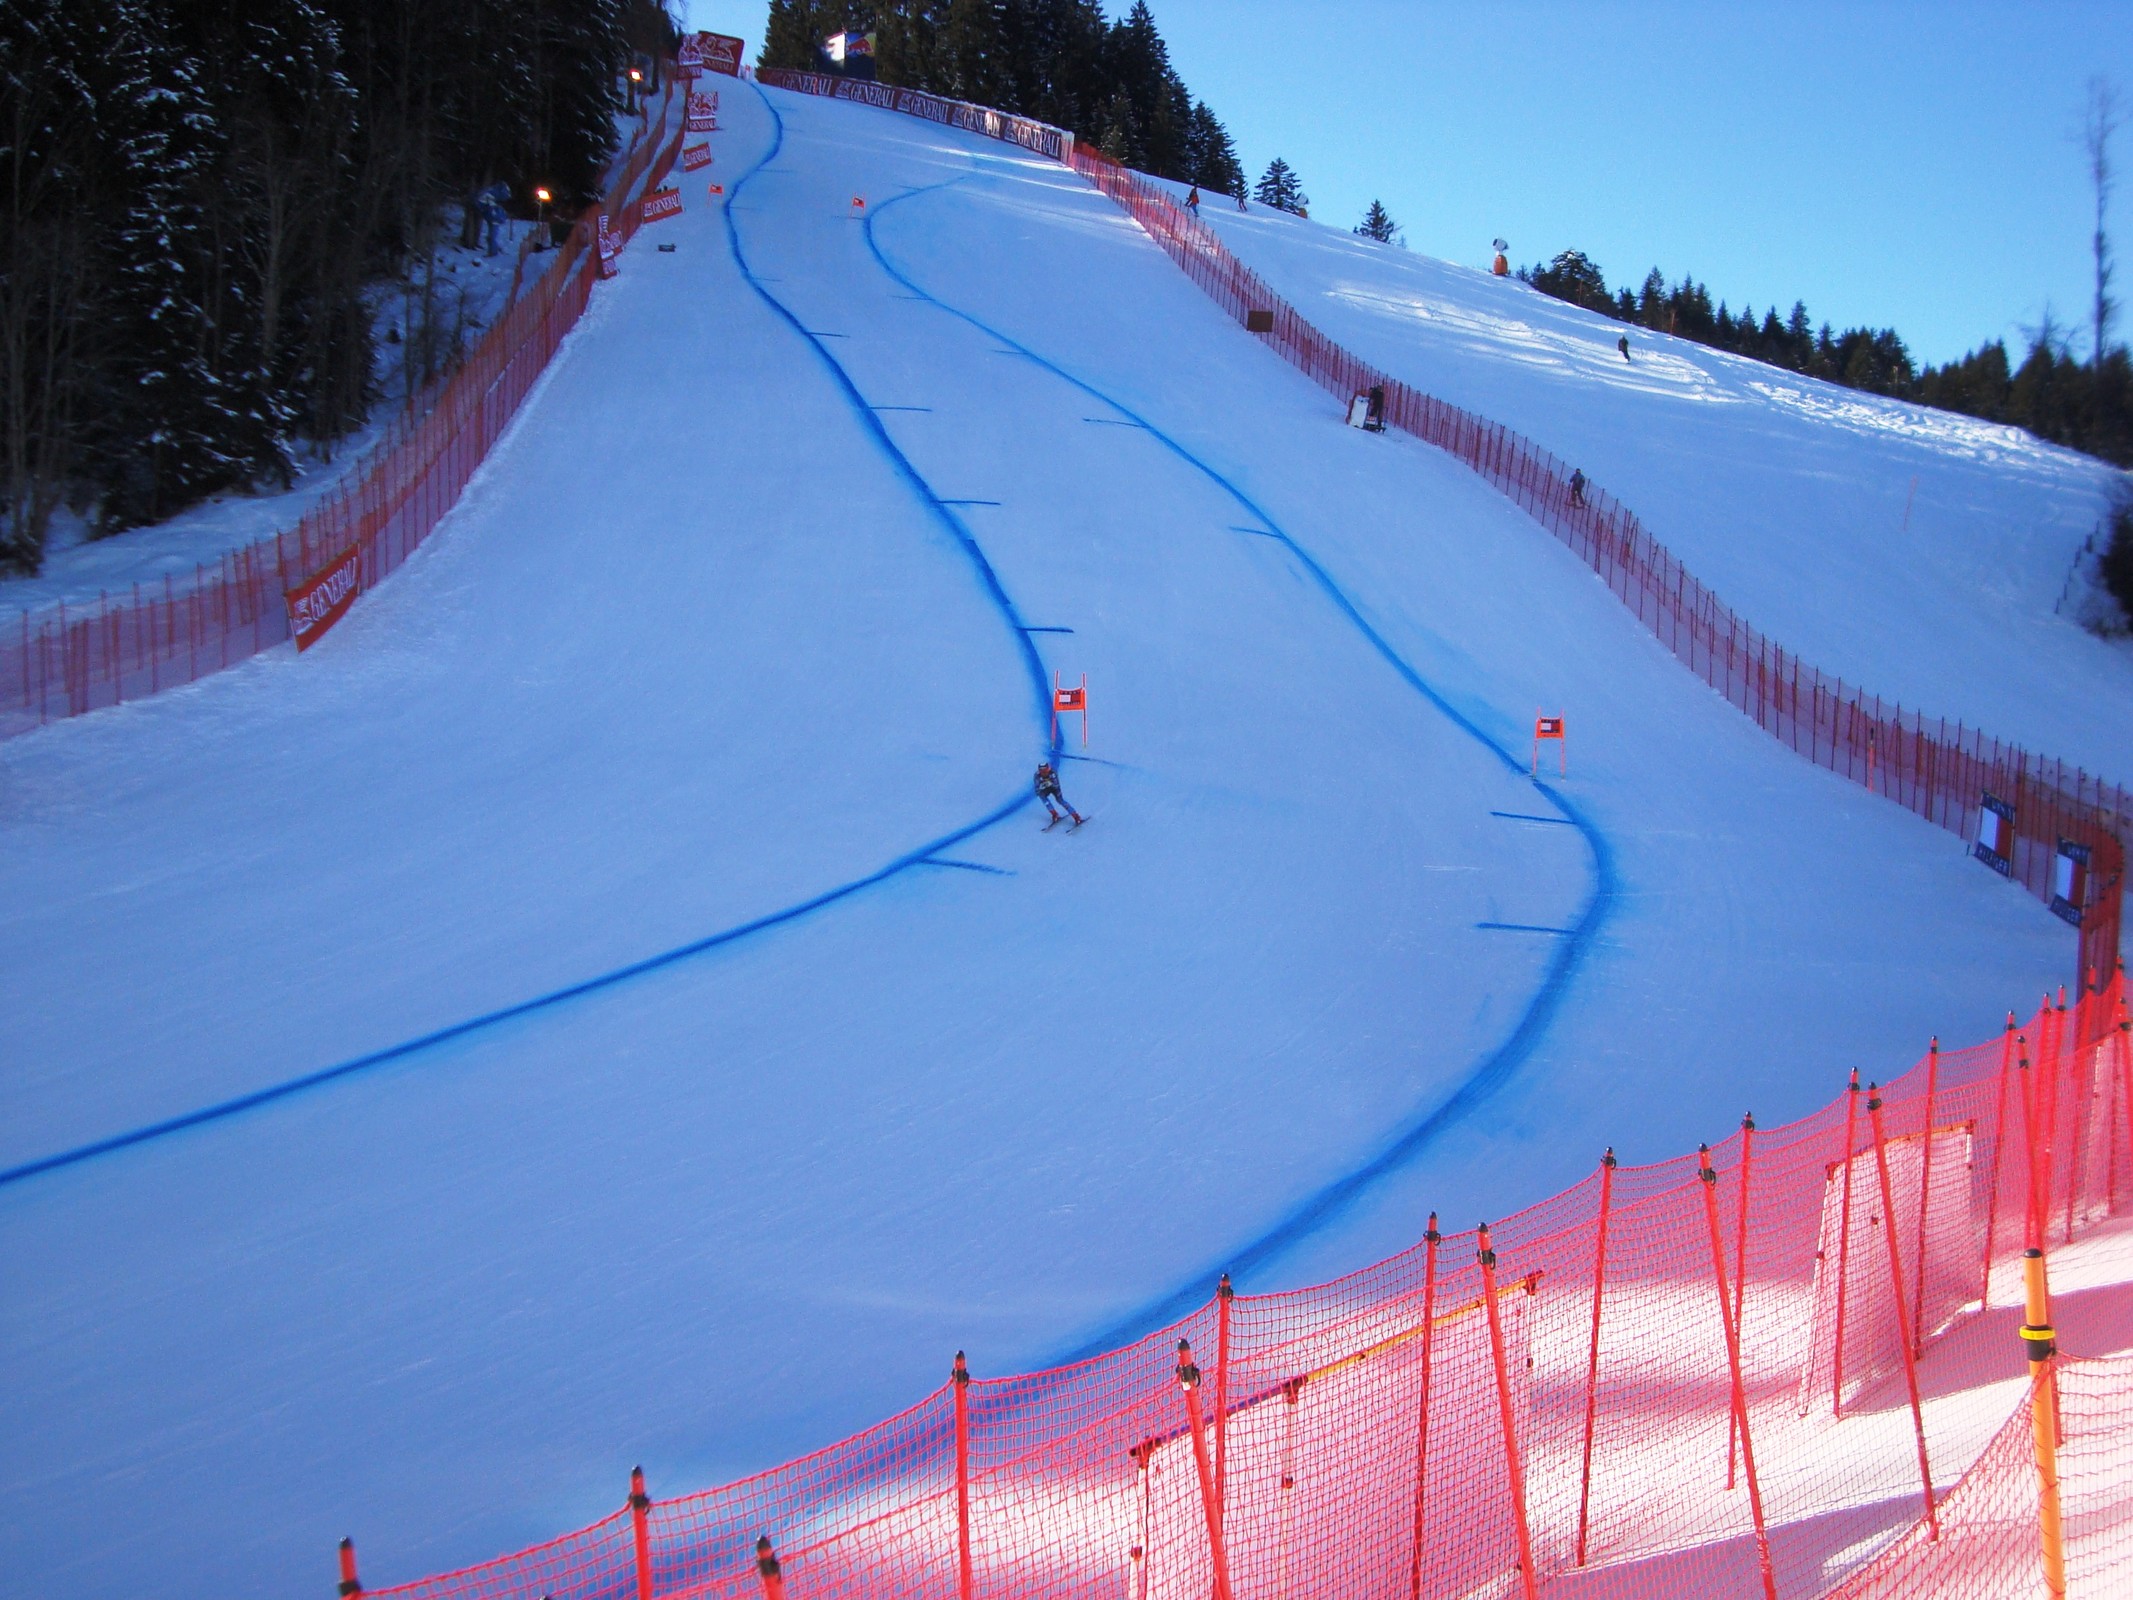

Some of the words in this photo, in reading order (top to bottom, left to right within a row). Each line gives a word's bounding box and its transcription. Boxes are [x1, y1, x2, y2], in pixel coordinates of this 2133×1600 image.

[782, 73, 833, 95] GENERALI
[850, 82, 895, 108] GENERALI
[911, 95, 949, 123] GENERALI
[963, 109, 1001, 137] GENERALI
[1017, 124, 1061, 157] GENERALI
[310, 556, 357, 622] GENERALI
